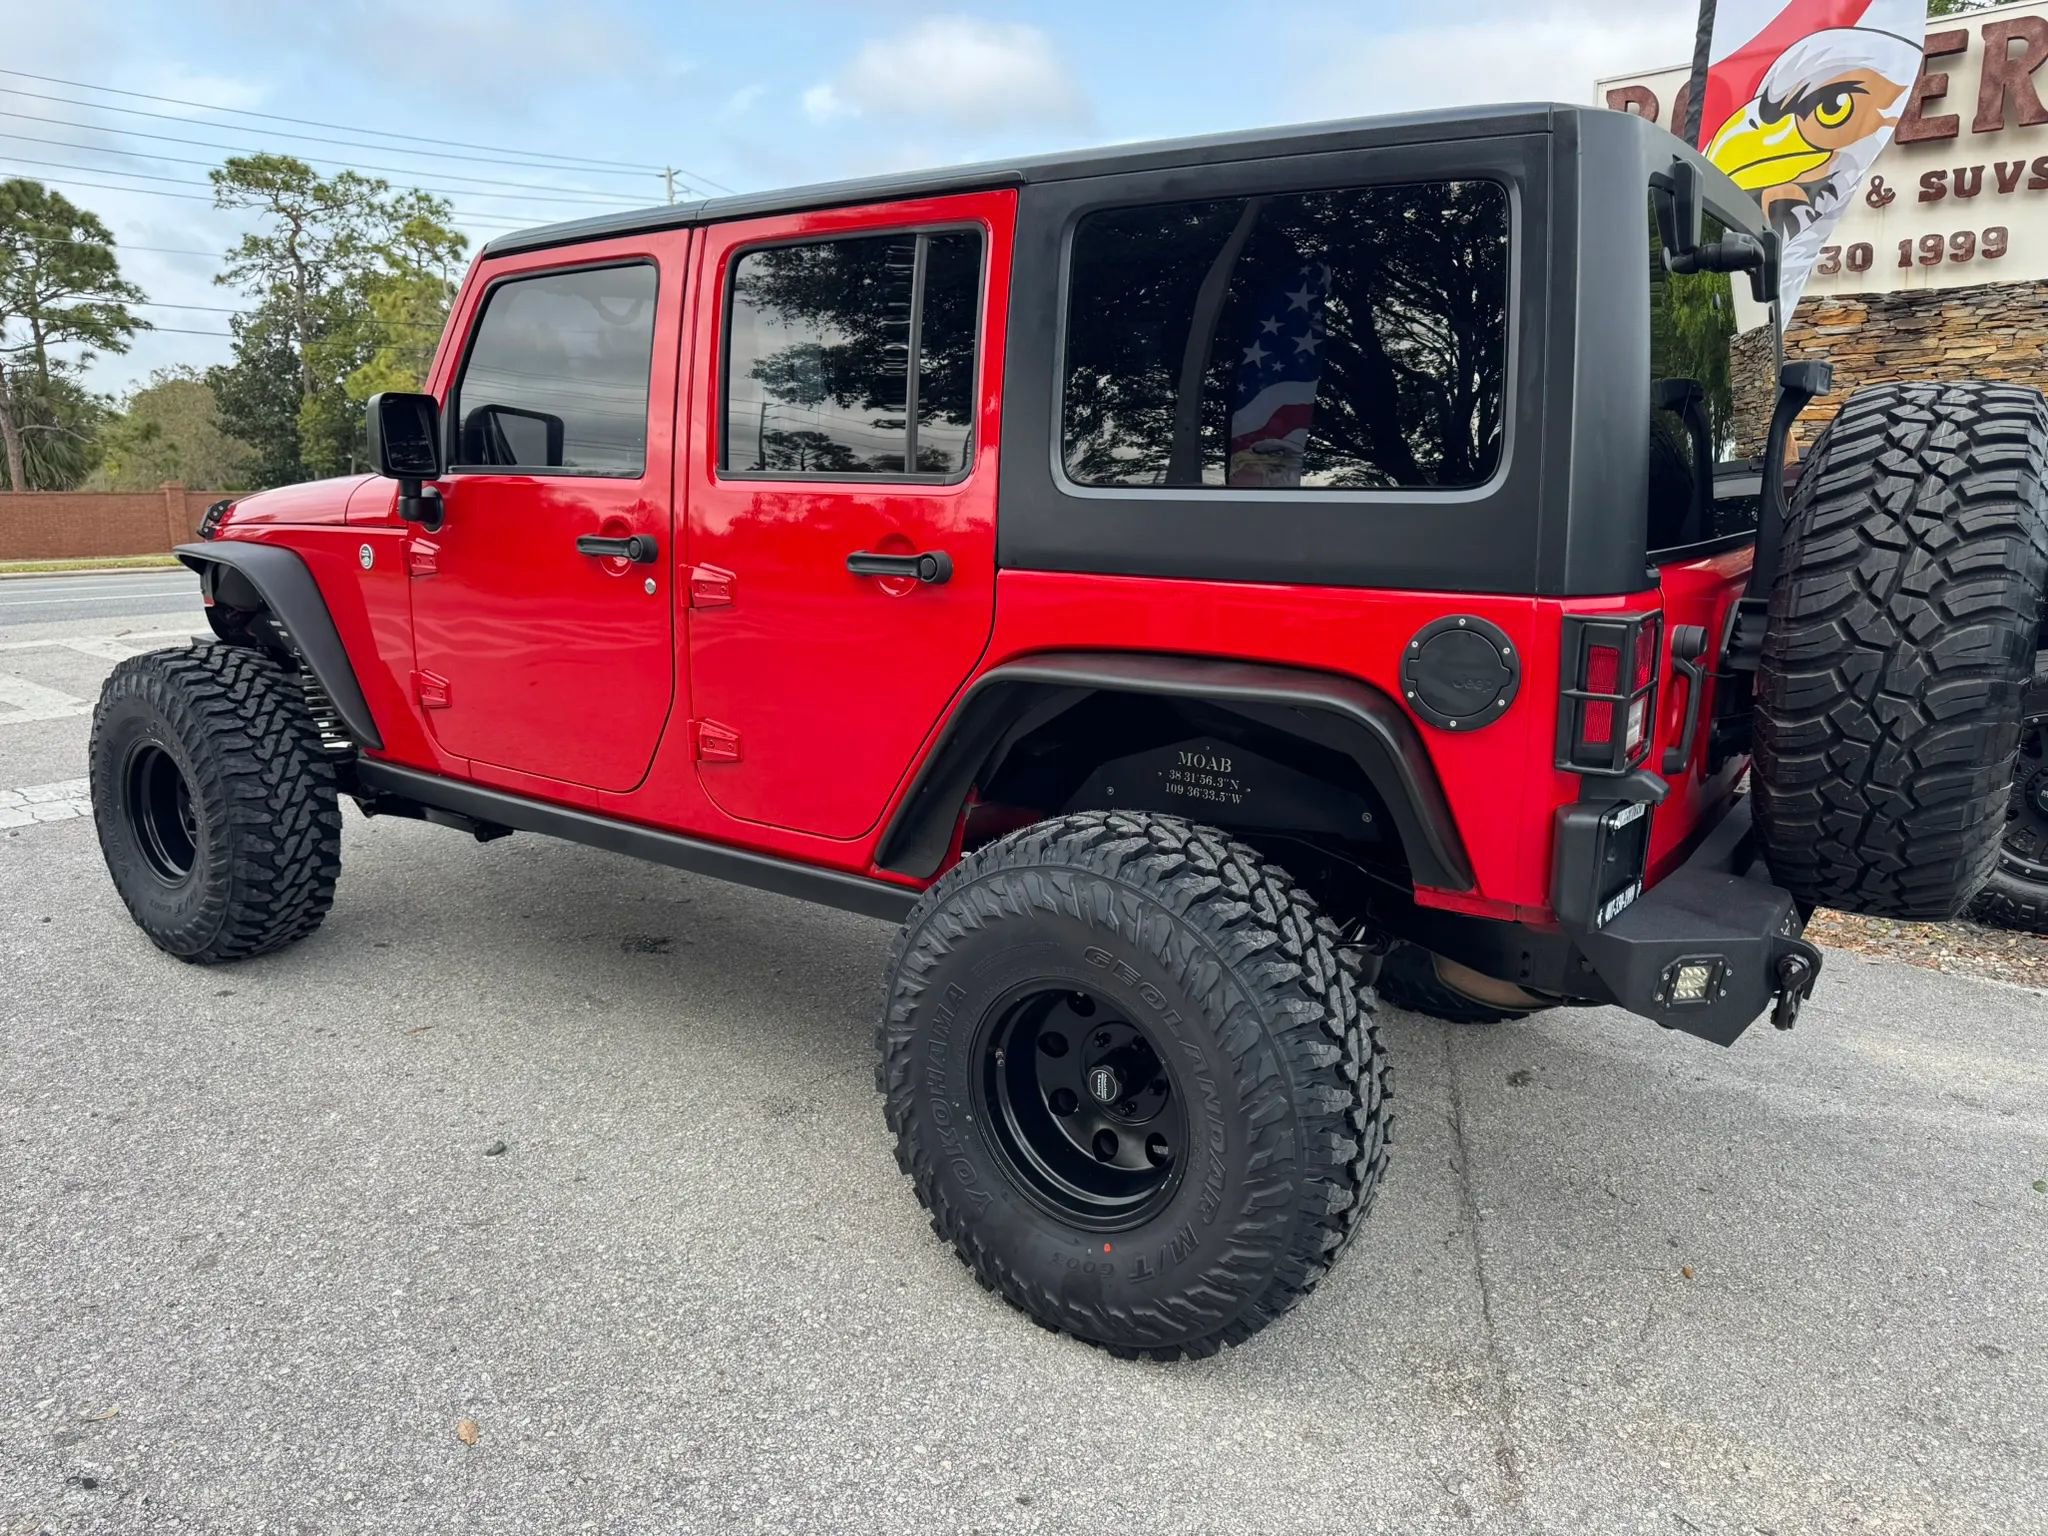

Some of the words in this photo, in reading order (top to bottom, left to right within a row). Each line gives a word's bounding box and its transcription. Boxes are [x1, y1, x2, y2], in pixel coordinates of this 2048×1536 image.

[1866, 175, 1896, 209] &
[1918, 156, 2048, 203] SUVS
[1898, 226, 2009, 268] 1999
[1168, 769, 1182, 781] 38
[1178, 751, 1232, 773] MOAB
[1165, 782, 1184, 795] 109
[927, 982, 996, 1215] YOKOHAMA
[1081, 945, 1229, 1226] GEOLANDAR
[1128, 1220, 1201, 1286] M/T
